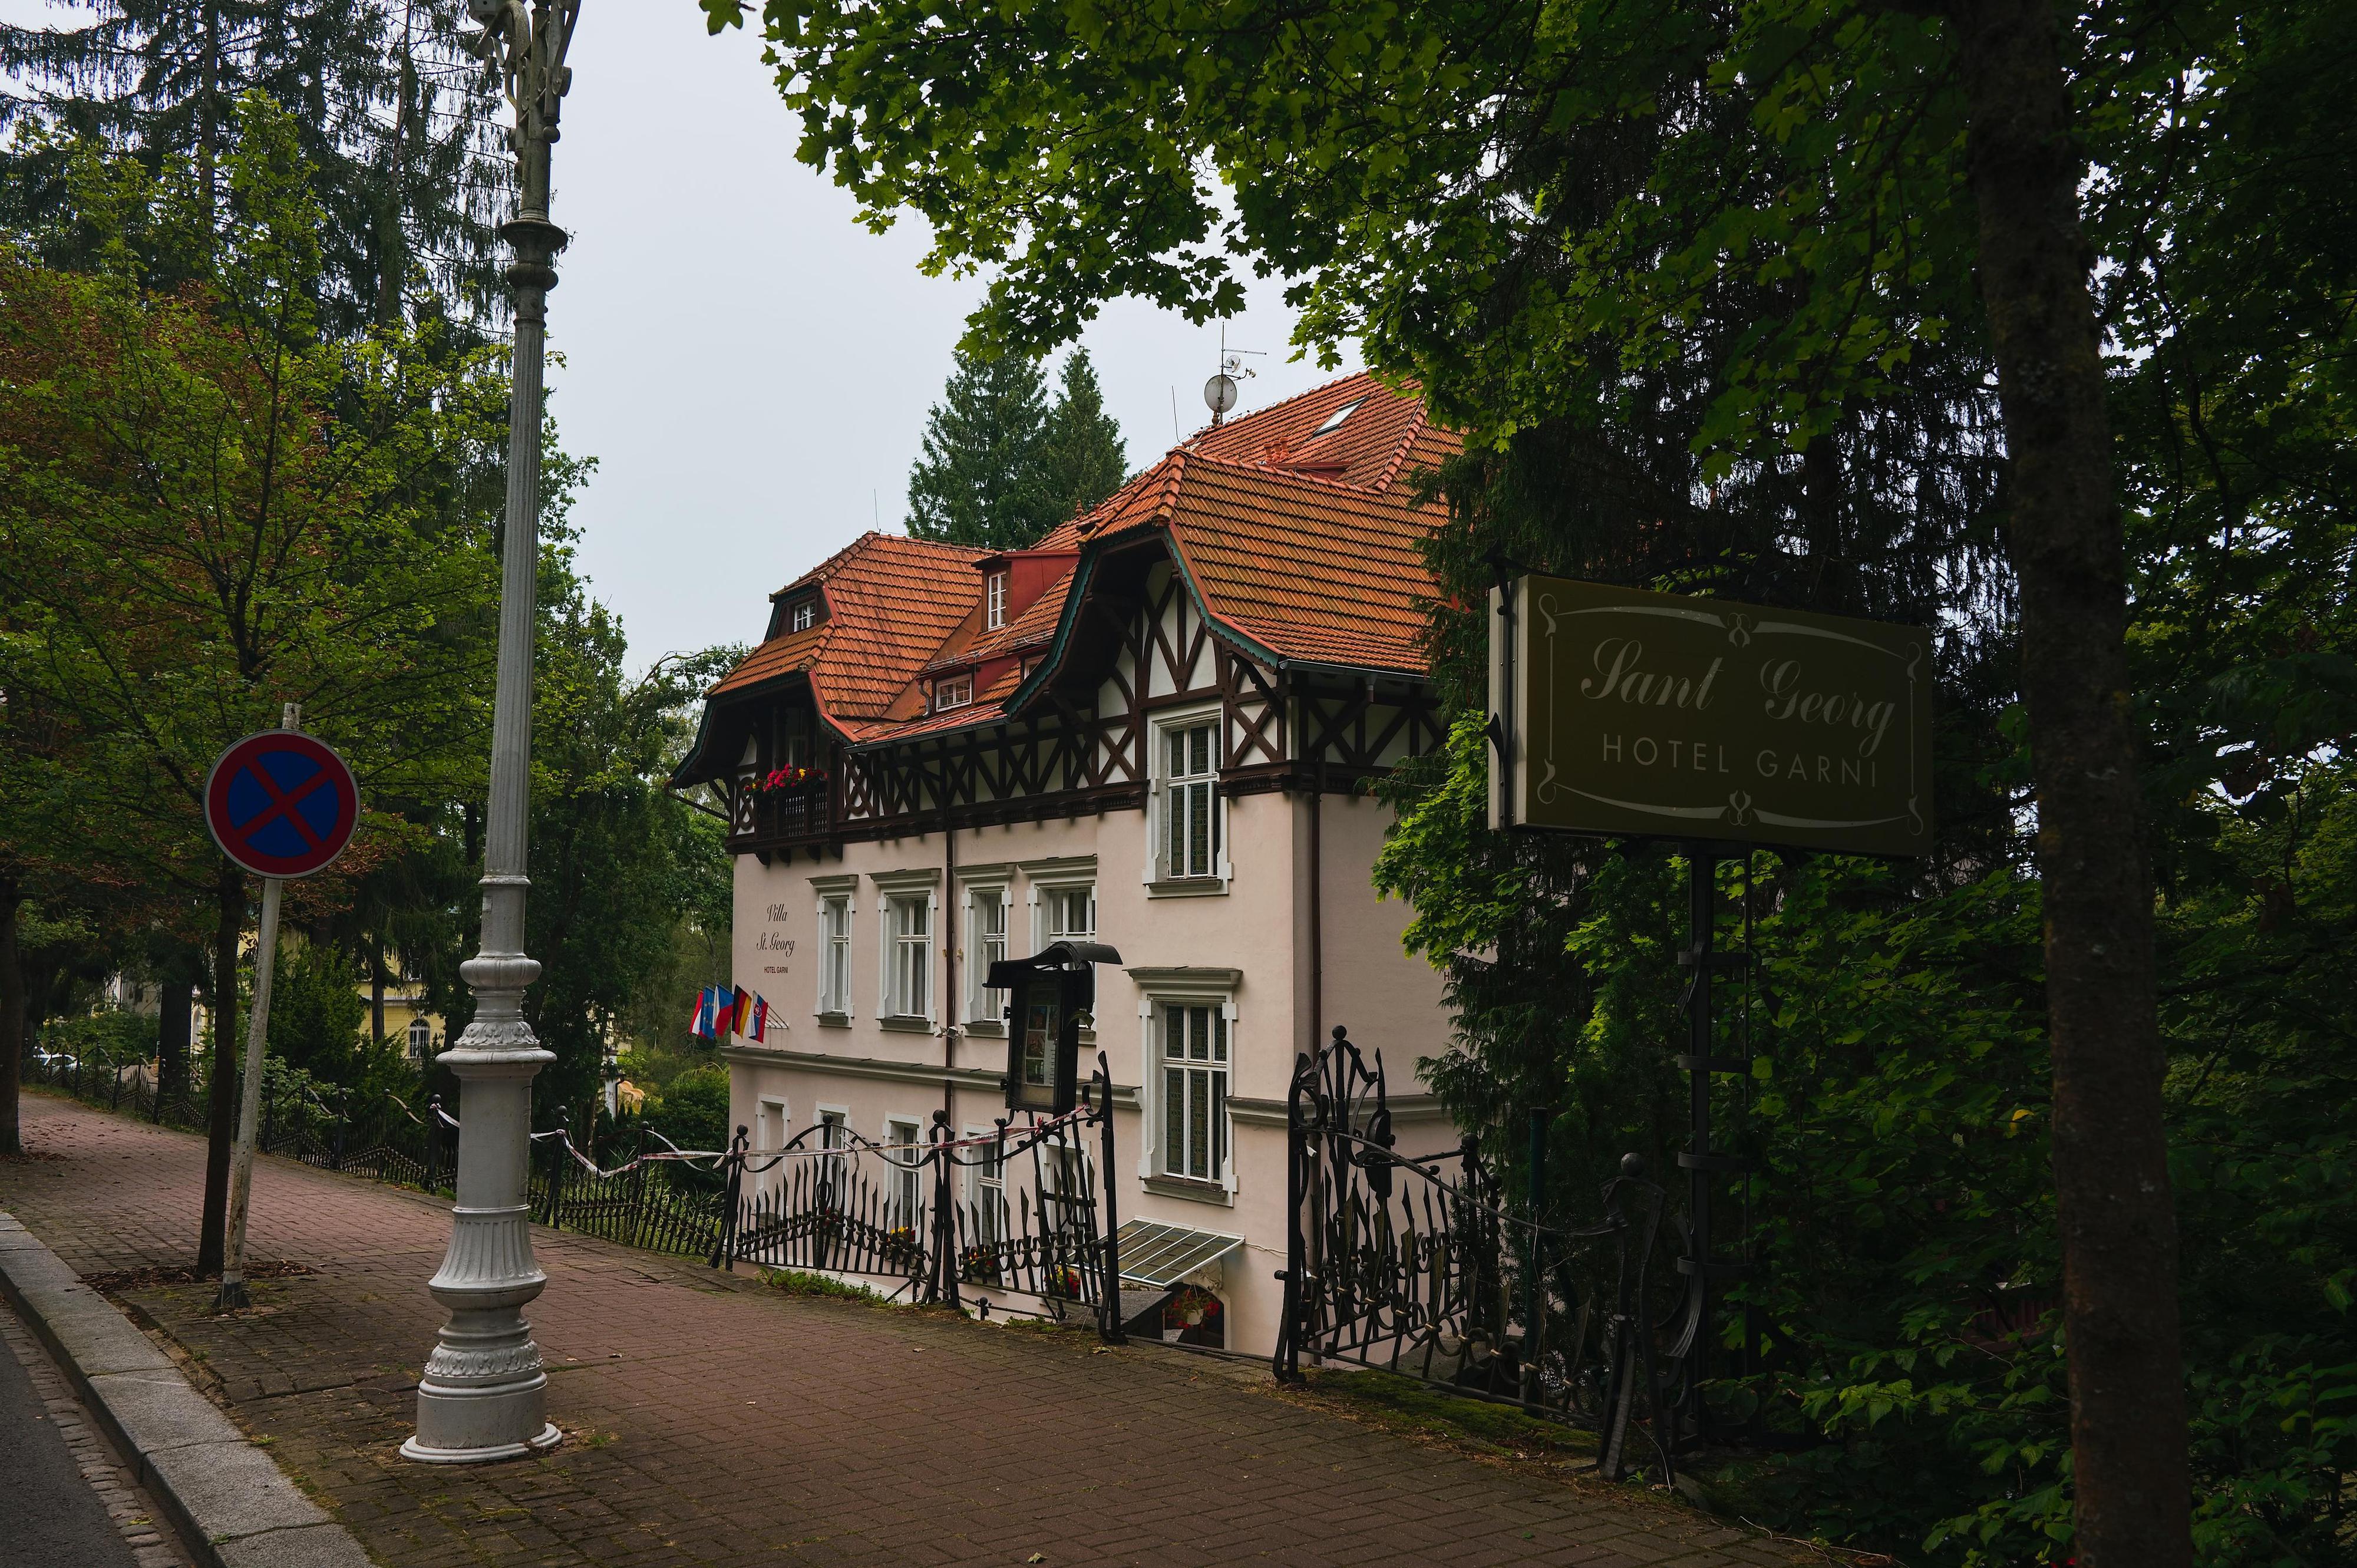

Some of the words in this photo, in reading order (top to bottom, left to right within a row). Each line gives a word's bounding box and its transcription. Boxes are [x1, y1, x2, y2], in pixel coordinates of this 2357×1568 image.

[1580, 636, 1724, 711] Sant
[1760, 658, 1896, 758] Georg
[1603, 733, 1729, 774] HOTEL
[1756, 750, 1877, 787] GARNI
[767, 903, 787, 922] Villa
[757, 932, 767, 950] St.
[770, 932, 795, 958] Georg
